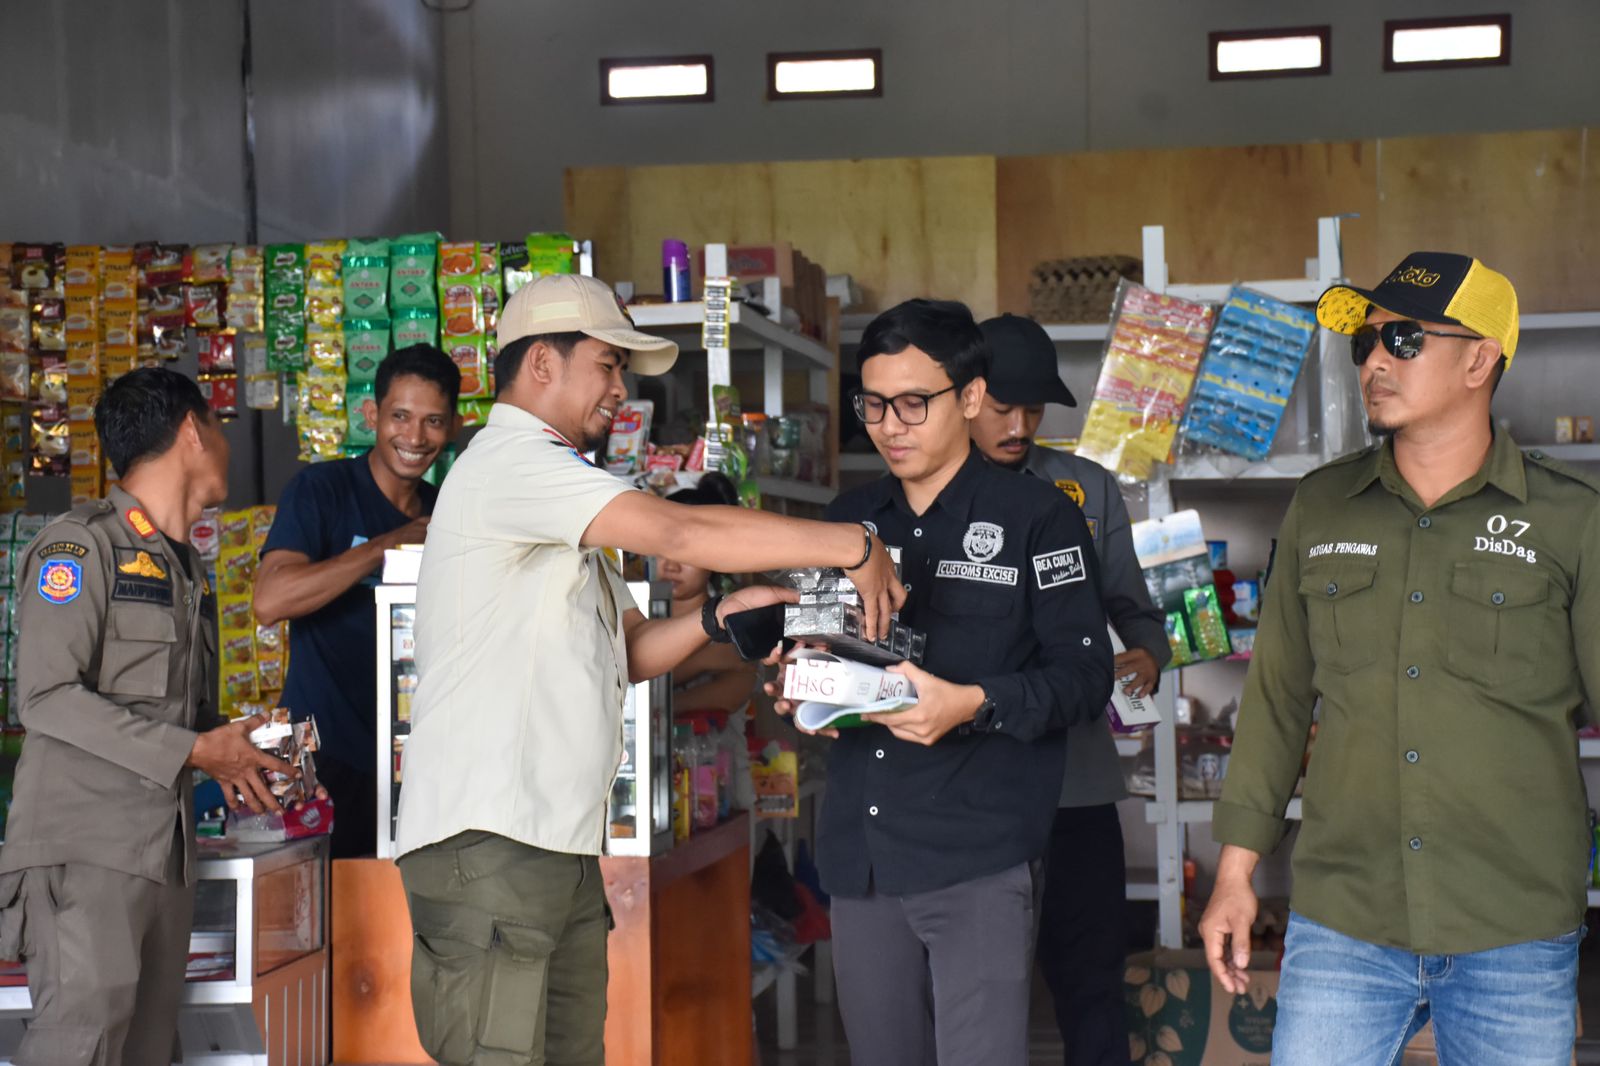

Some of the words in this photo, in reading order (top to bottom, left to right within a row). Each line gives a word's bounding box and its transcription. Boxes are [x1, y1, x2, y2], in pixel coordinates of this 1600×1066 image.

[1486, 514, 1531, 537] 07
[1308, 543, 1334, 559] SATGAS
[1334, 542, 1378, 556] PENGAWAS
[1473, 536, 1537, 564] DisDag
[1036, 557, 1053, 572] BEA
[1052, 552, 1075, 568] CUKAI
[940, 563, 982, 578] CUSTOMS
[982, 567, 1014, 582] EXCISE
[796, 675, 836, 696] H&G
